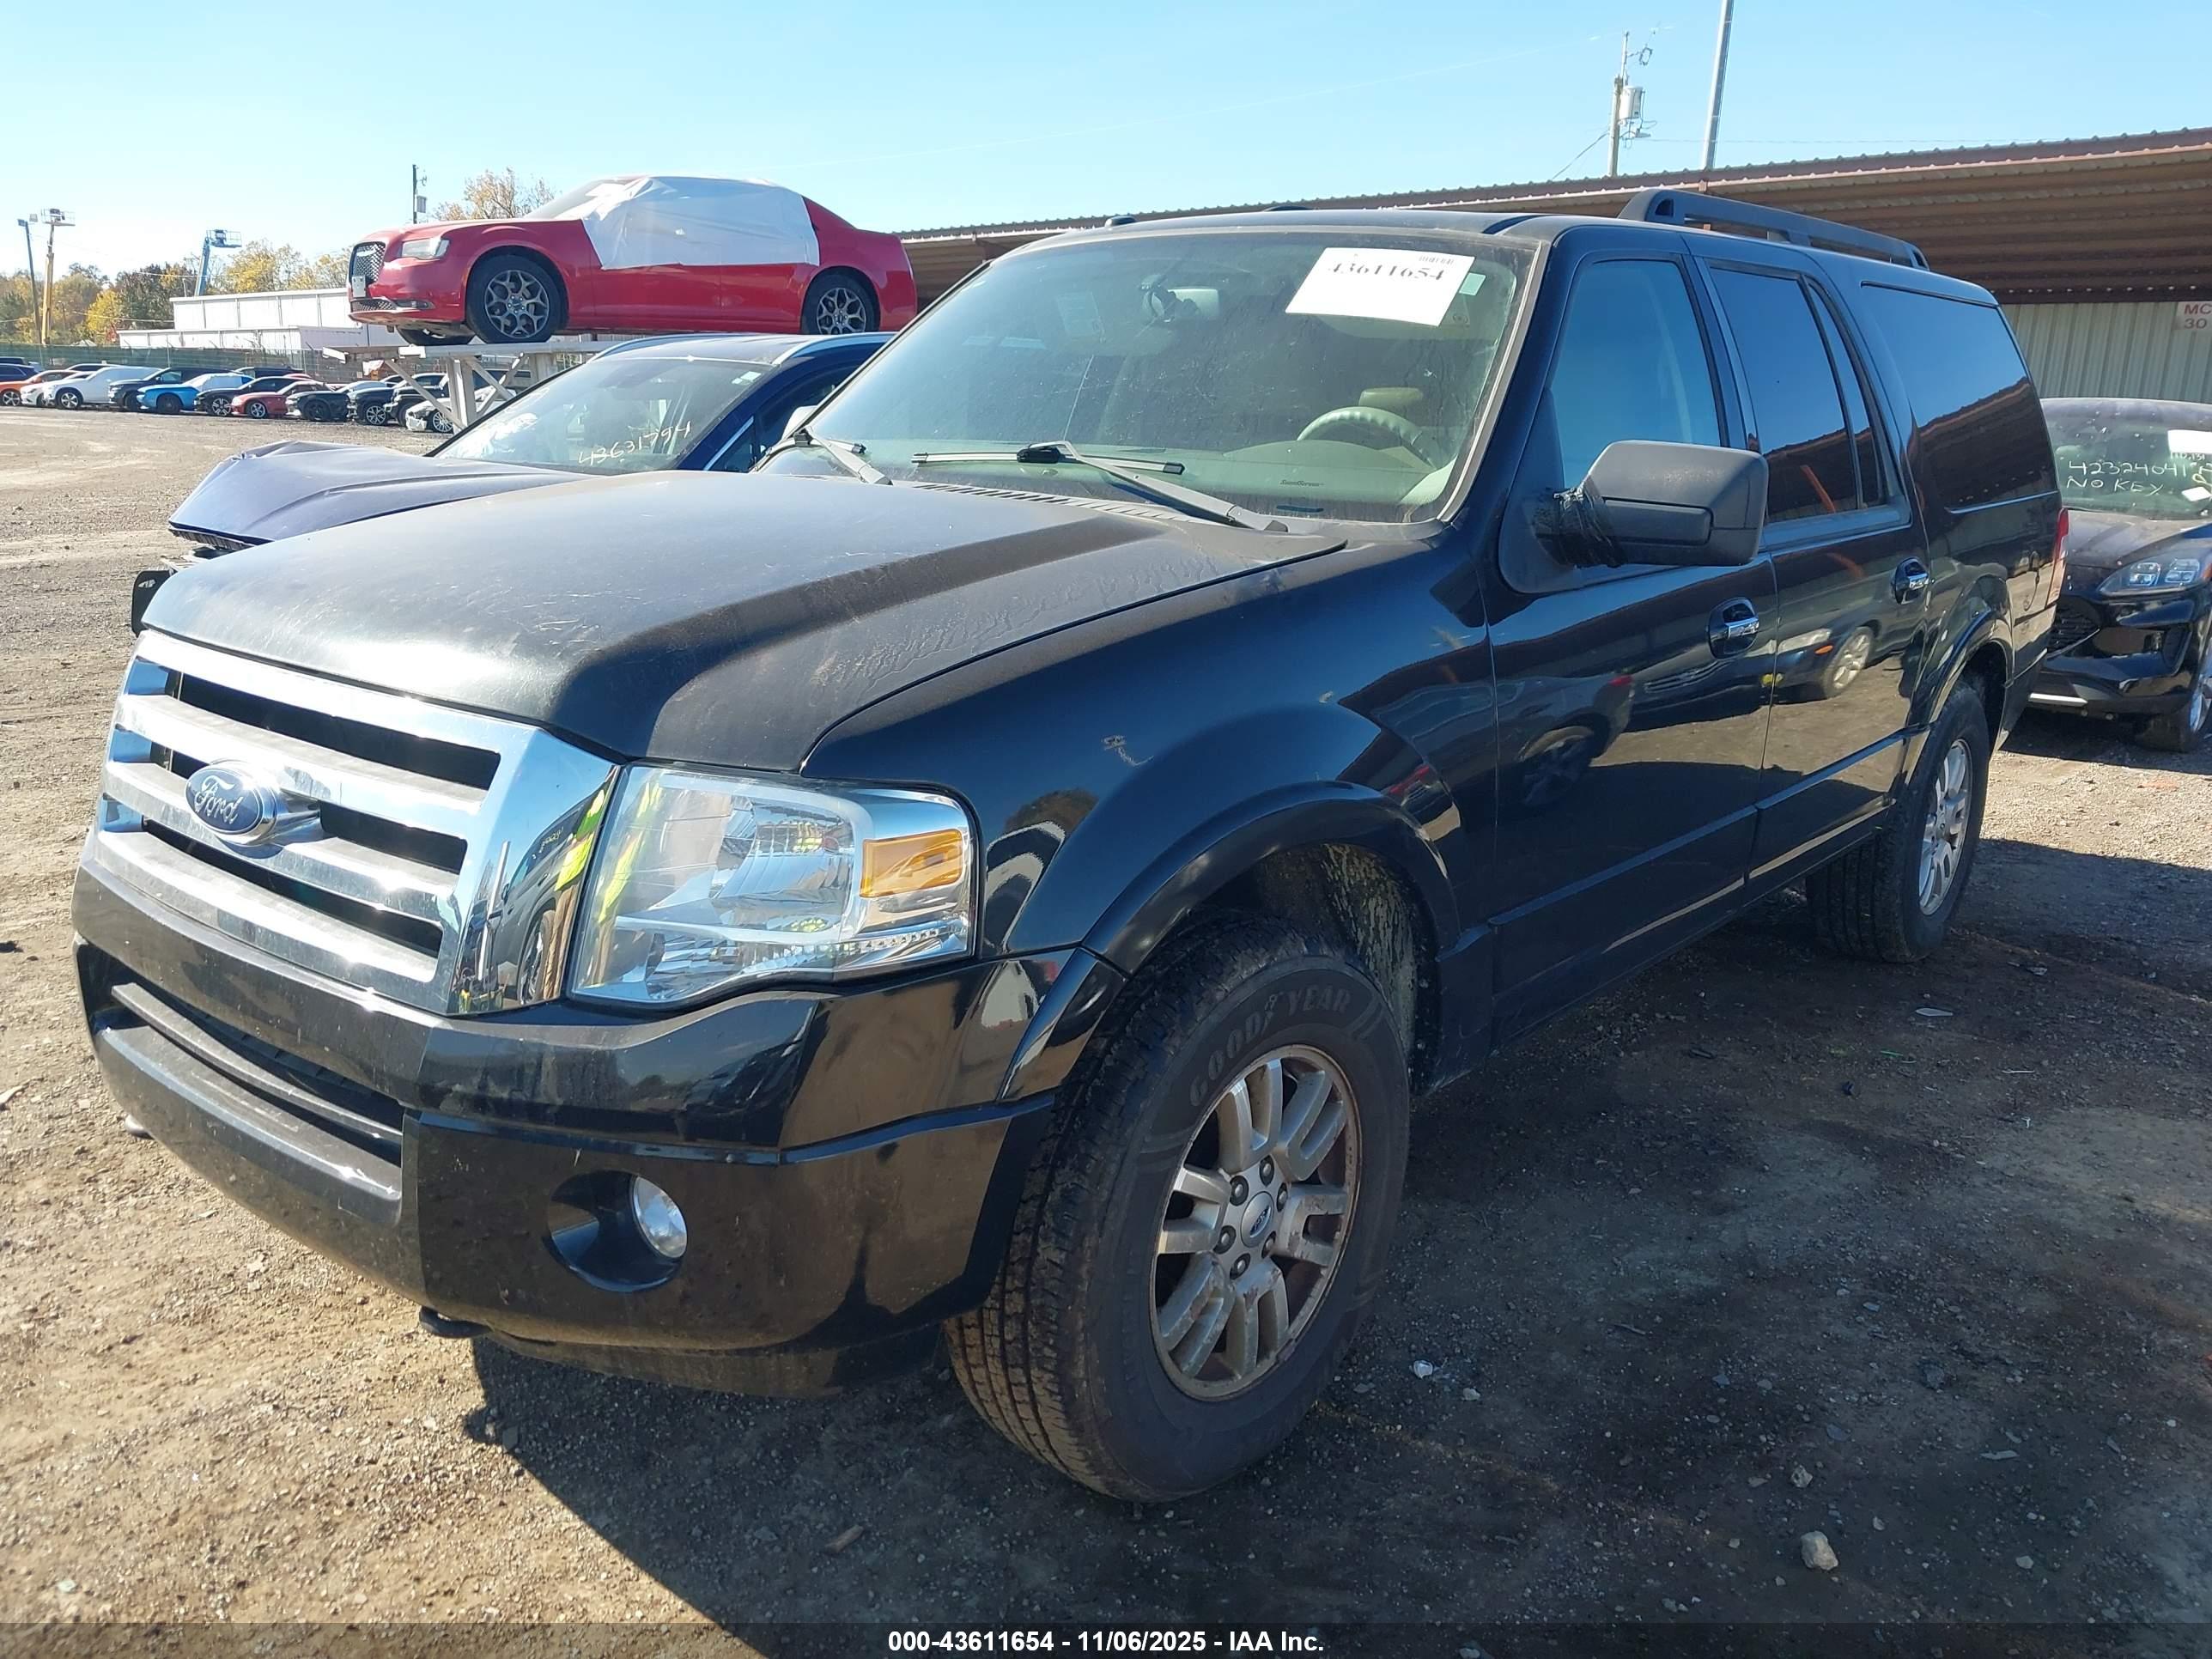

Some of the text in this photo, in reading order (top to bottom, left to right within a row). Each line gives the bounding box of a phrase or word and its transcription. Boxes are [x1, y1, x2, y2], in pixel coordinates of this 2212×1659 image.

[2184, 318, 2208, 329] 30
[2066, 477, 2165, 496] NO KEY
[193, 775, 245, 825] Ford
